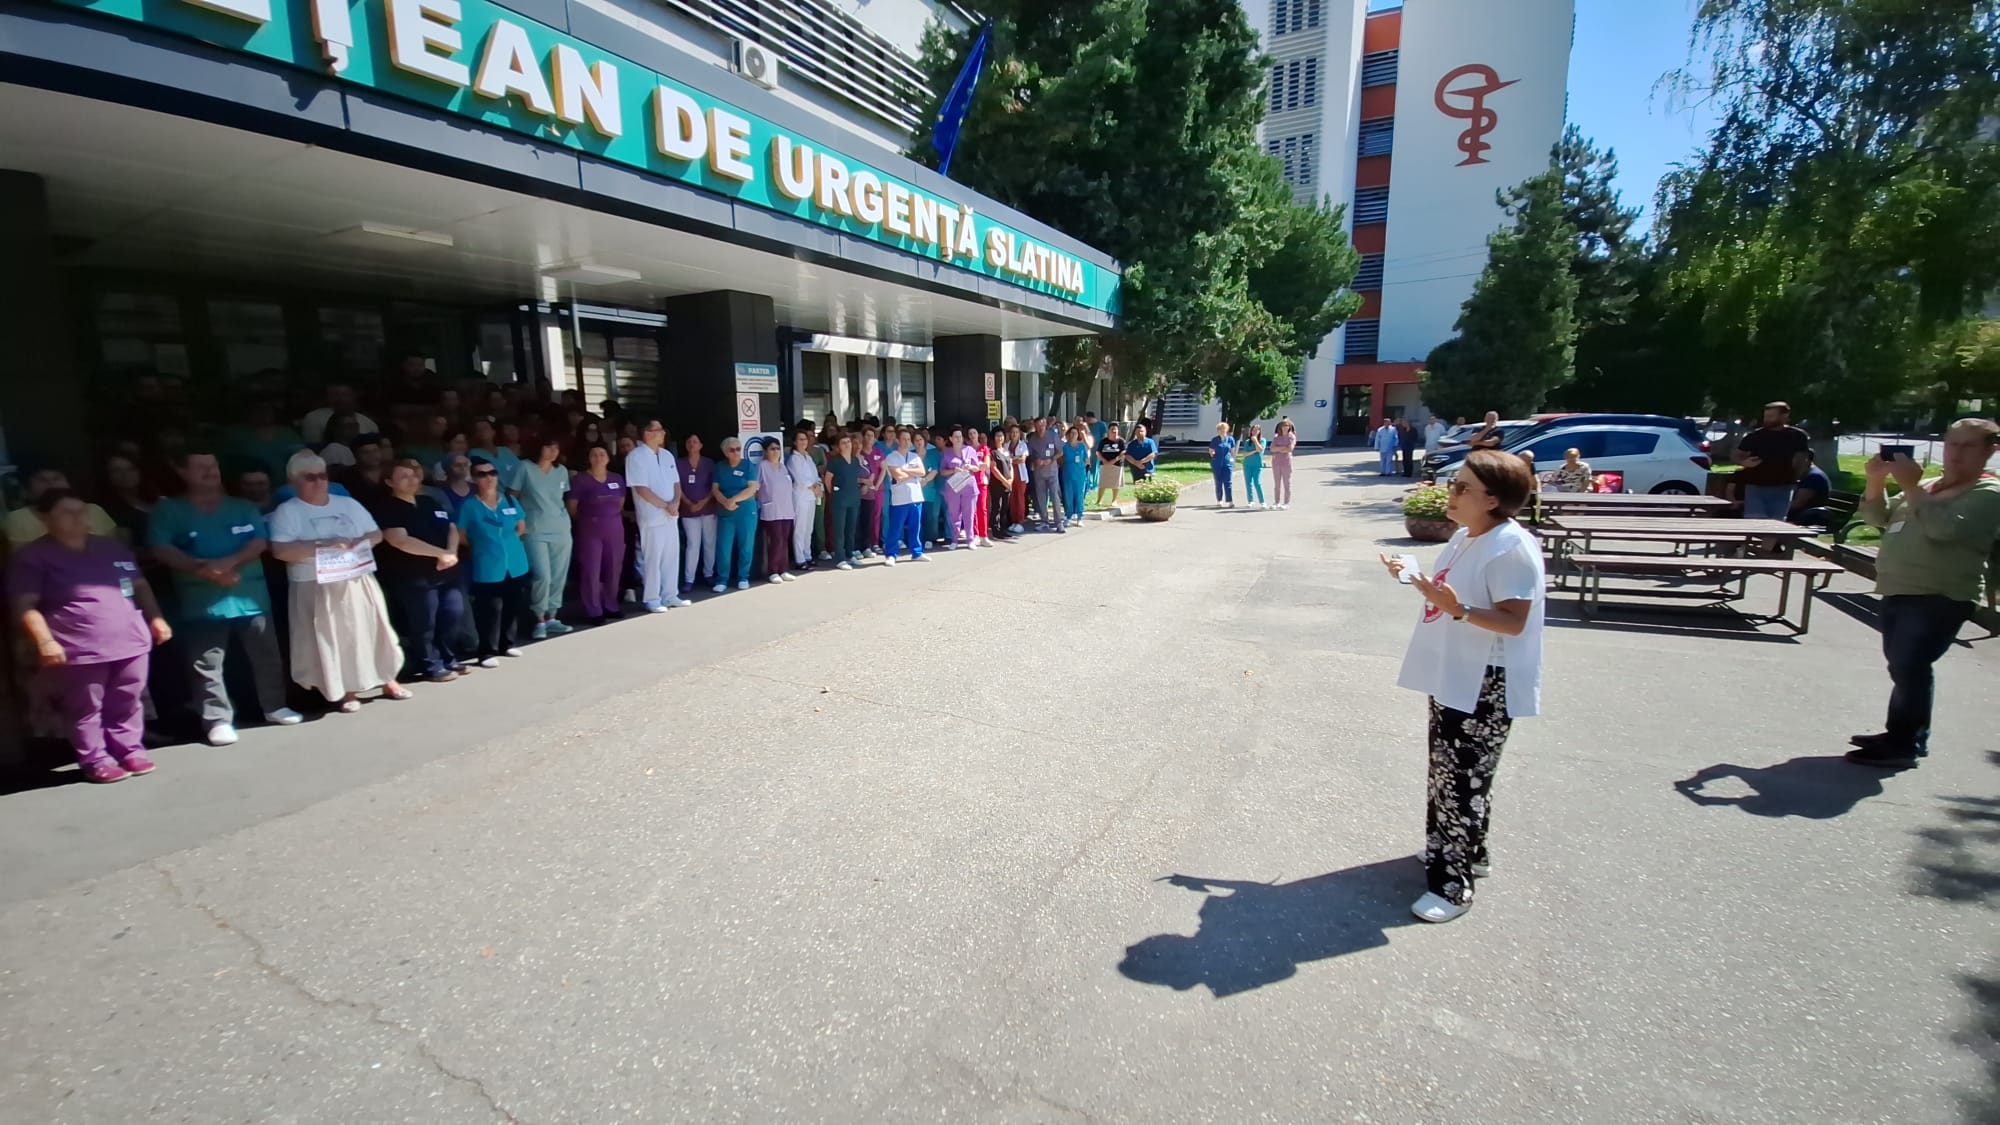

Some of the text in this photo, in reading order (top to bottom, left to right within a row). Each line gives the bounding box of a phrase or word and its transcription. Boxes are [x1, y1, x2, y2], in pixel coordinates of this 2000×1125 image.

[654, 84, 754, 181] DE
[771, 134, 980, 262] URGENȚĂ
[986, 226, 1085, 293] SLATINA
